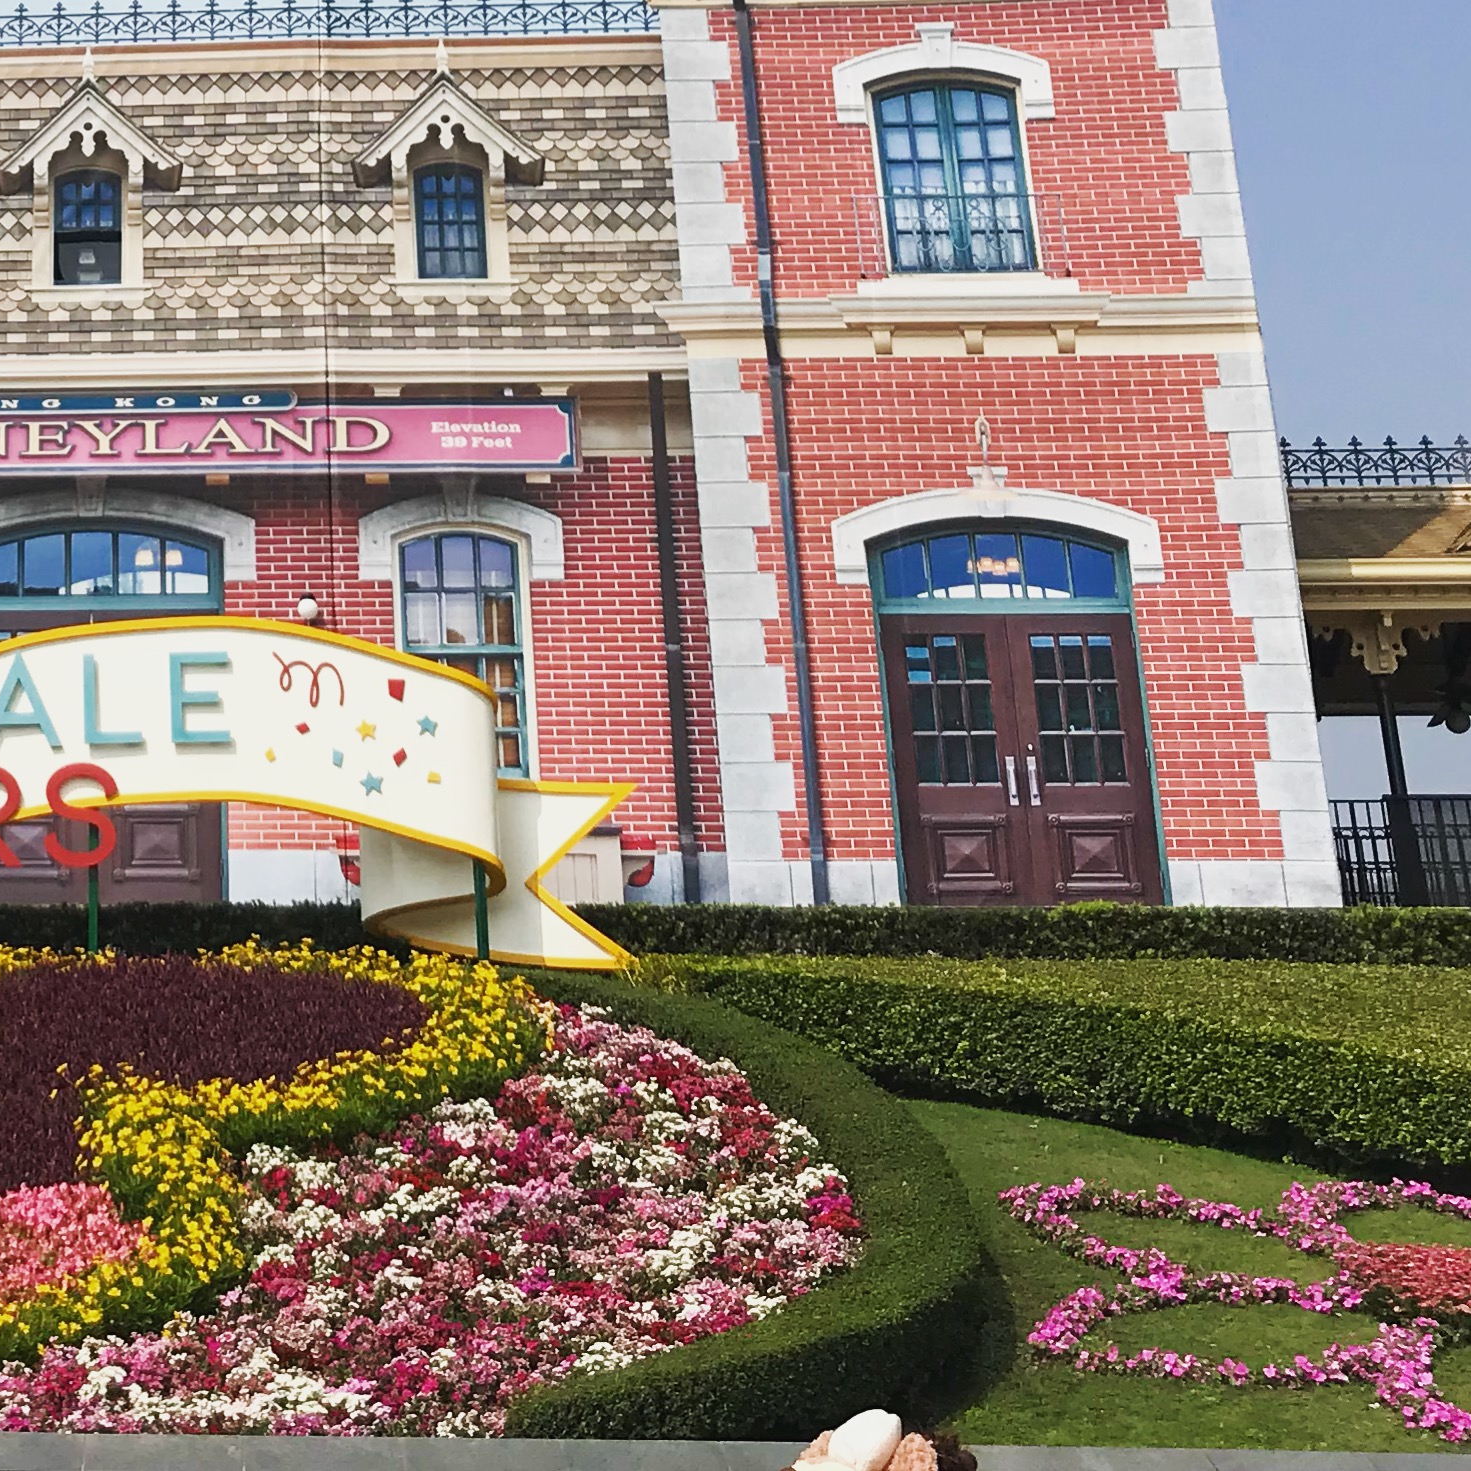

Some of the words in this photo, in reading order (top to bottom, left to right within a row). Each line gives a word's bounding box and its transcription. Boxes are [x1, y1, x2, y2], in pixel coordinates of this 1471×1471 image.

[114, 394, 262, 409] KONG
[430, 420, 522, 434] Elevation
[471, 435, 513, 448] Feet
